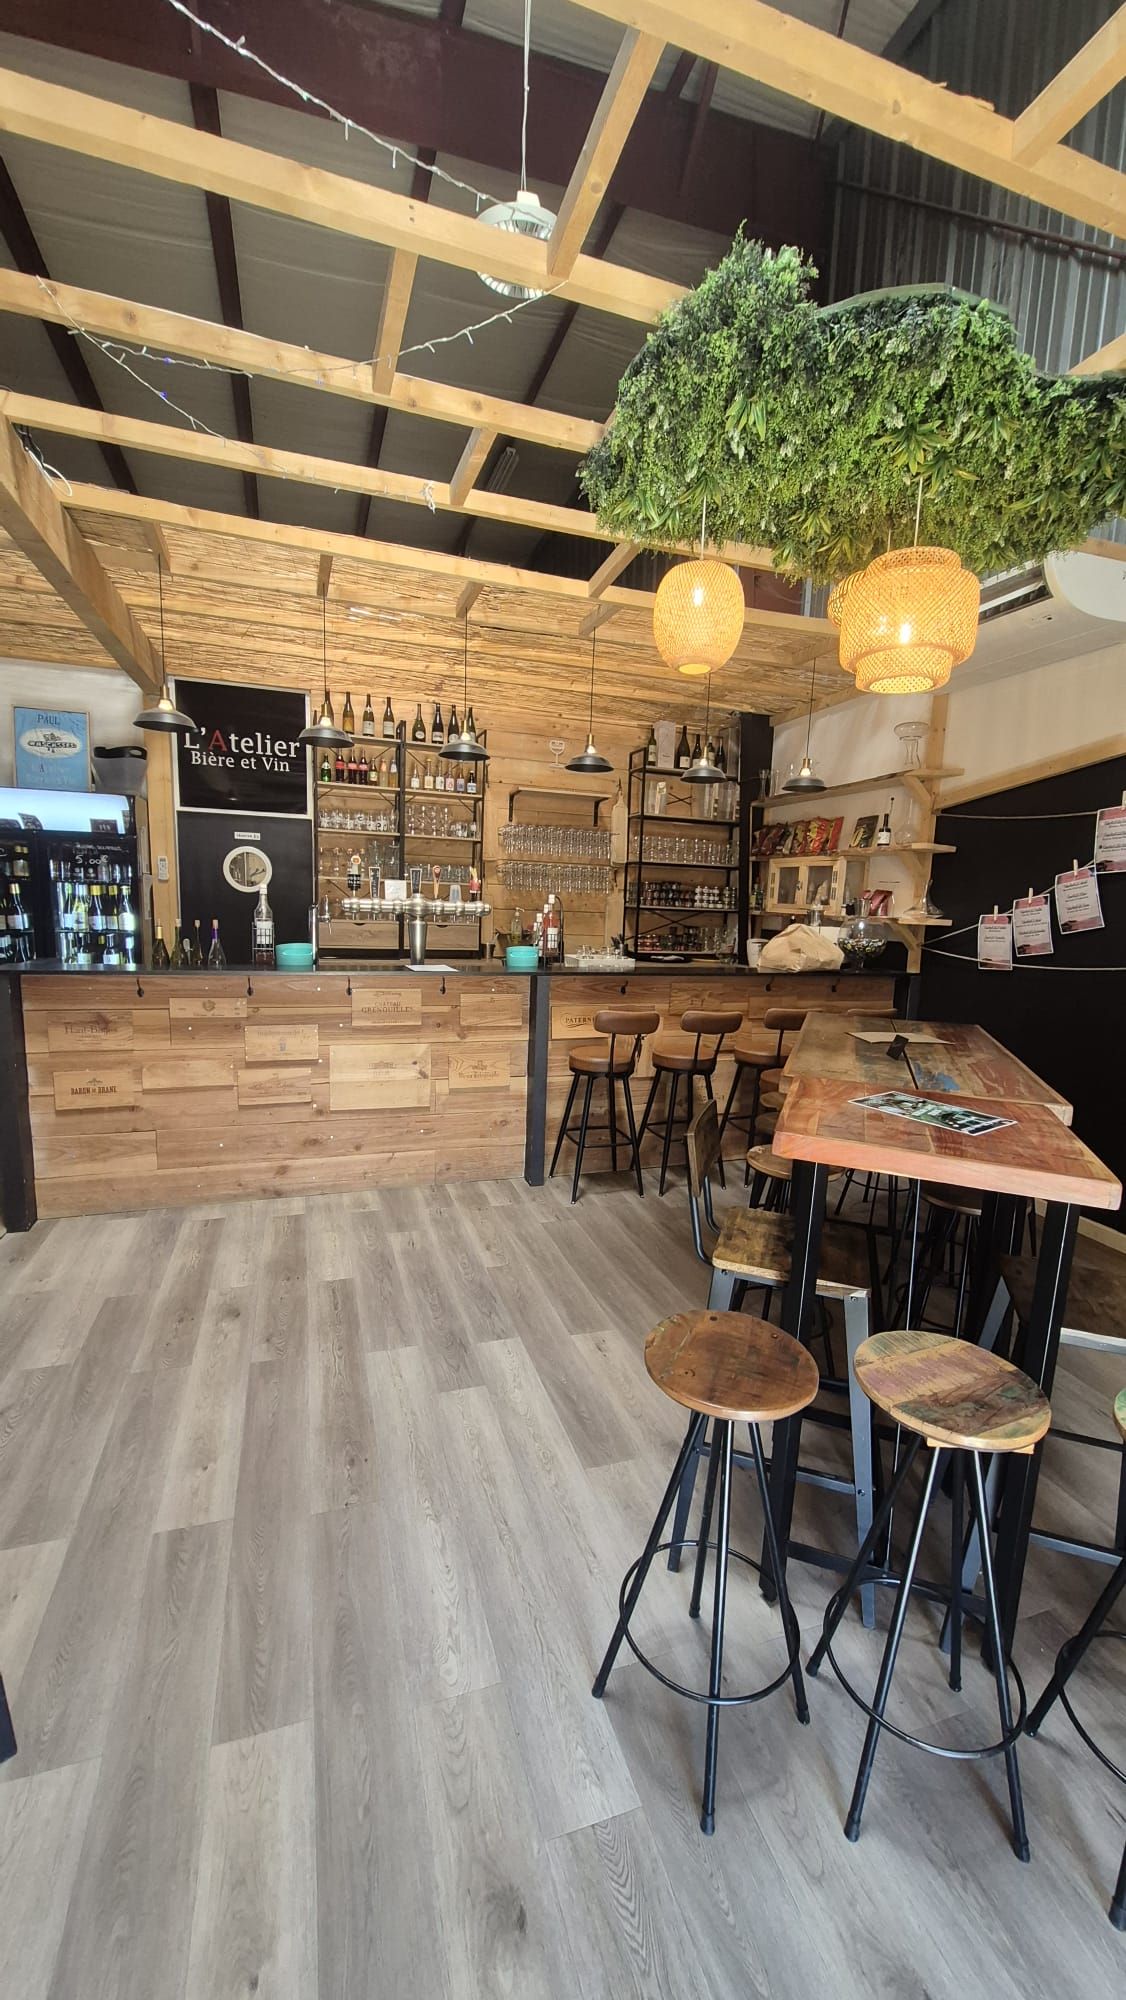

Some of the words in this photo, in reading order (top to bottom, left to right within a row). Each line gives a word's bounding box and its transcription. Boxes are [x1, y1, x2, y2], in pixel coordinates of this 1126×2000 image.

[37, 713, 60, 725] PAUL
[184, 727, 300, 758] L'Atelier
[191, 750, 235, 768] Bière
[240, 757, 257, 770] et
[262, 757, 290, 772] Vin
